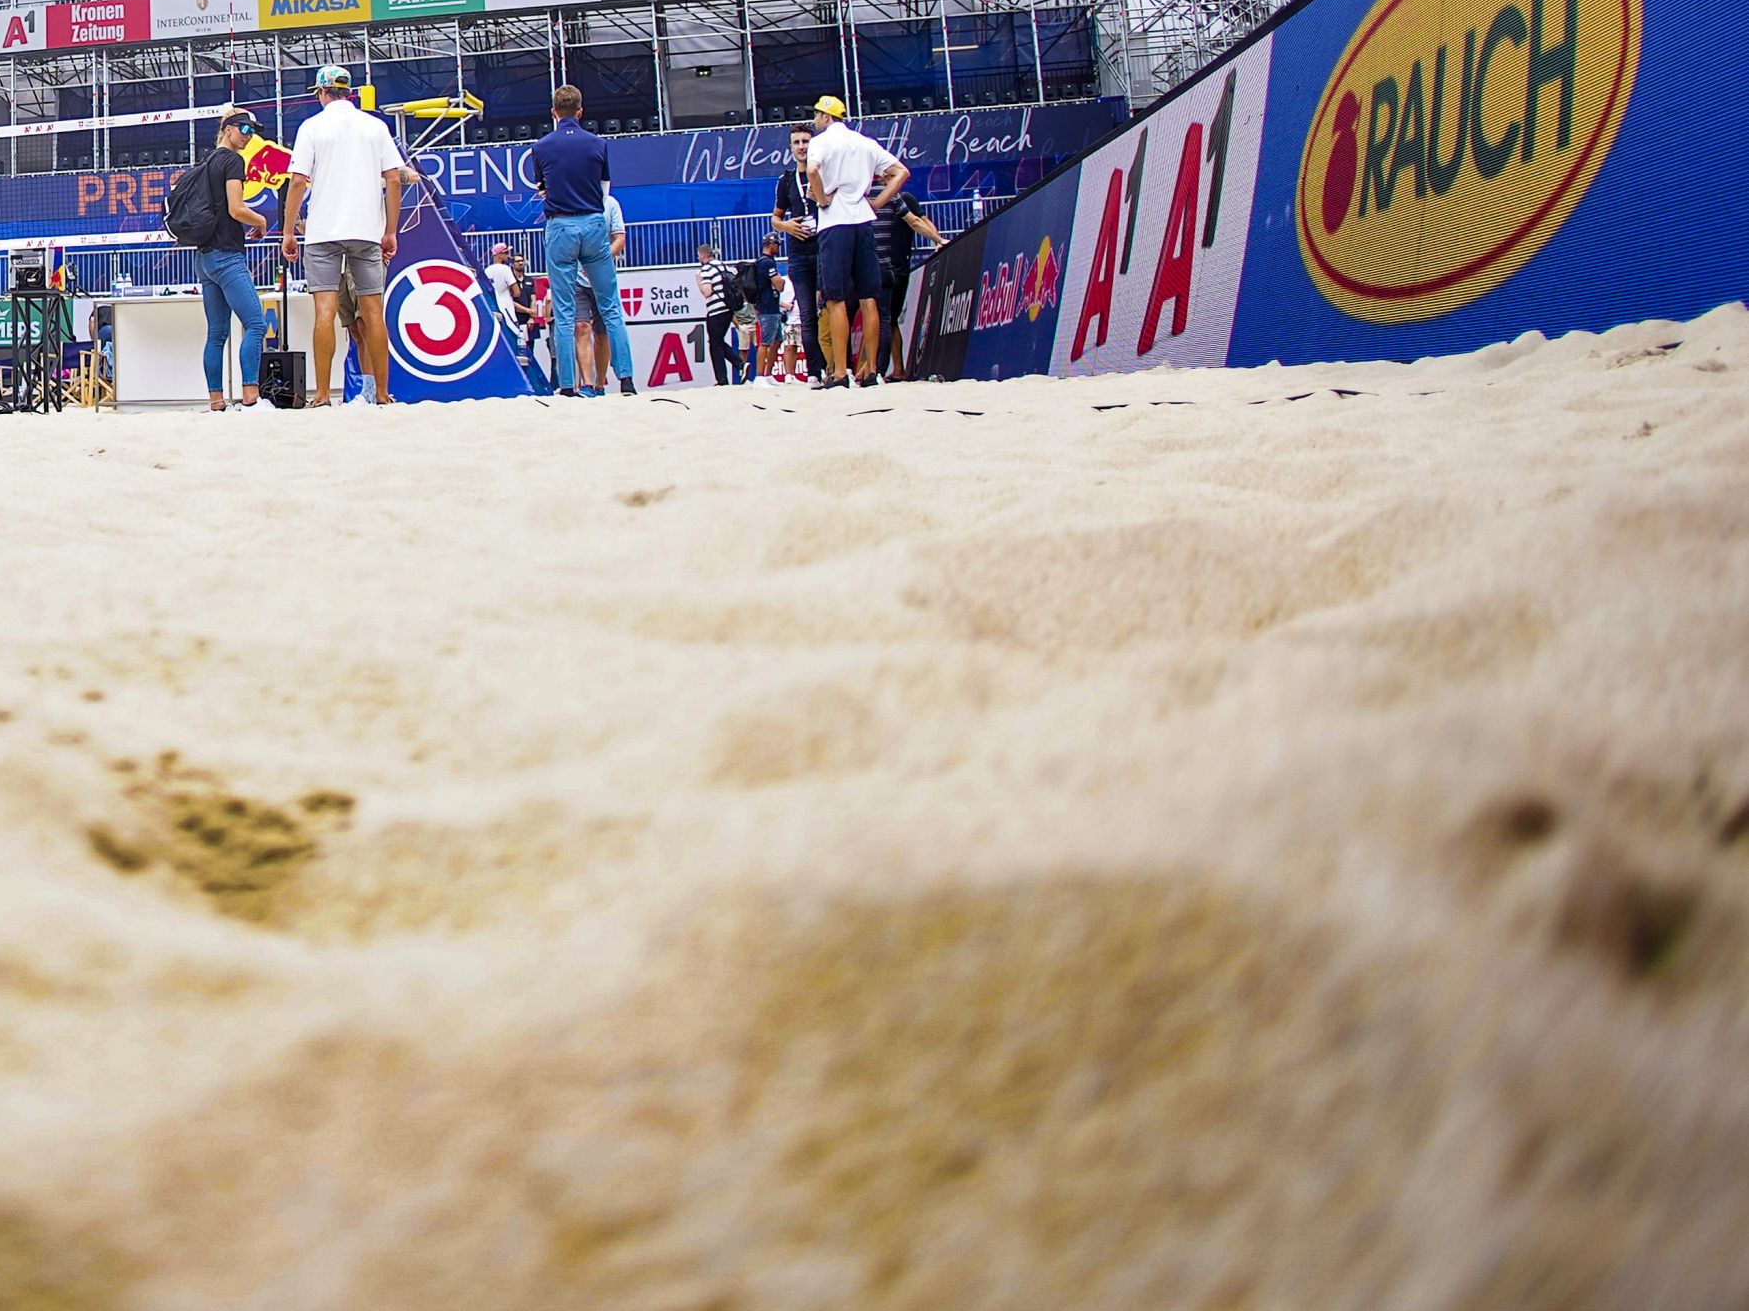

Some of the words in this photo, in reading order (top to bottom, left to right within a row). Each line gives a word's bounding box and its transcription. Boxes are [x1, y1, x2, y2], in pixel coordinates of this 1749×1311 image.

[3, 10, 35, 49] A1
[71, 3, 124, 23] Kronen
[71, 23, 124, 43] Zeitung
[947, 108, 1033, 165] Beach
[1137, 68, 1236, 356] A1
[1072, 126, 1147, 364] A1
[650, 285, 689, 300] Stadt
[651, 301, 689, 315] Wien
[940, 280, 974, 336] Vienna
[974, 271, 996, 331] Red
[991, 253, 1023, 326] Bull
[648, 324, 705, 388] A1
